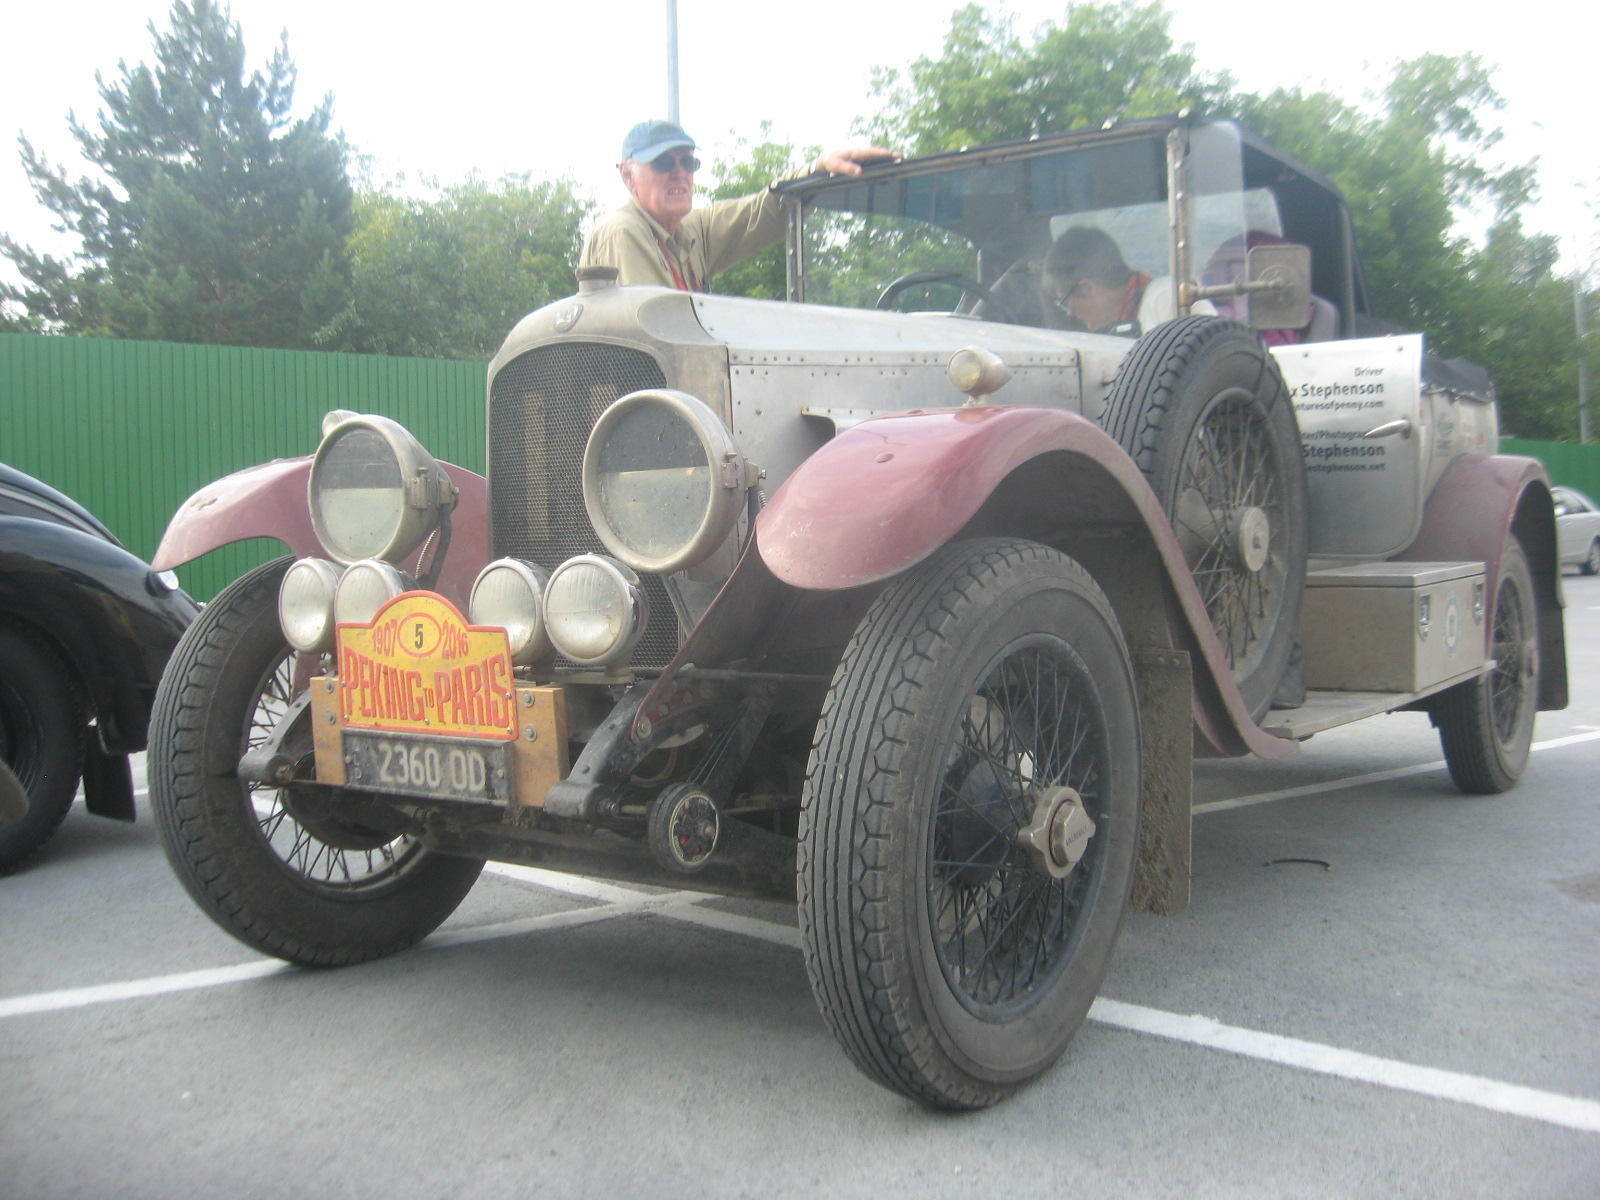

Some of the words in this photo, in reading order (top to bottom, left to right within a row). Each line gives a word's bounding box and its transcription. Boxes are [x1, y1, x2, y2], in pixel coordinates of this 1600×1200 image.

[1354, 367, 1384, 376] Driver
[1301, 382, 1384, 399] Stephenson
[1302, 443, 1385, 461] Stephenson
[372, 619, 398, 657] 1907
[414, 624, 424, 649] 5
[441, 619, 469, 660] 2016
[344, 645, 426, 721] PEKING
[423, 687, 435, 708] TO
[433, 653, 509, 729] PARIS
[378, 743, 442, 787] 2360
